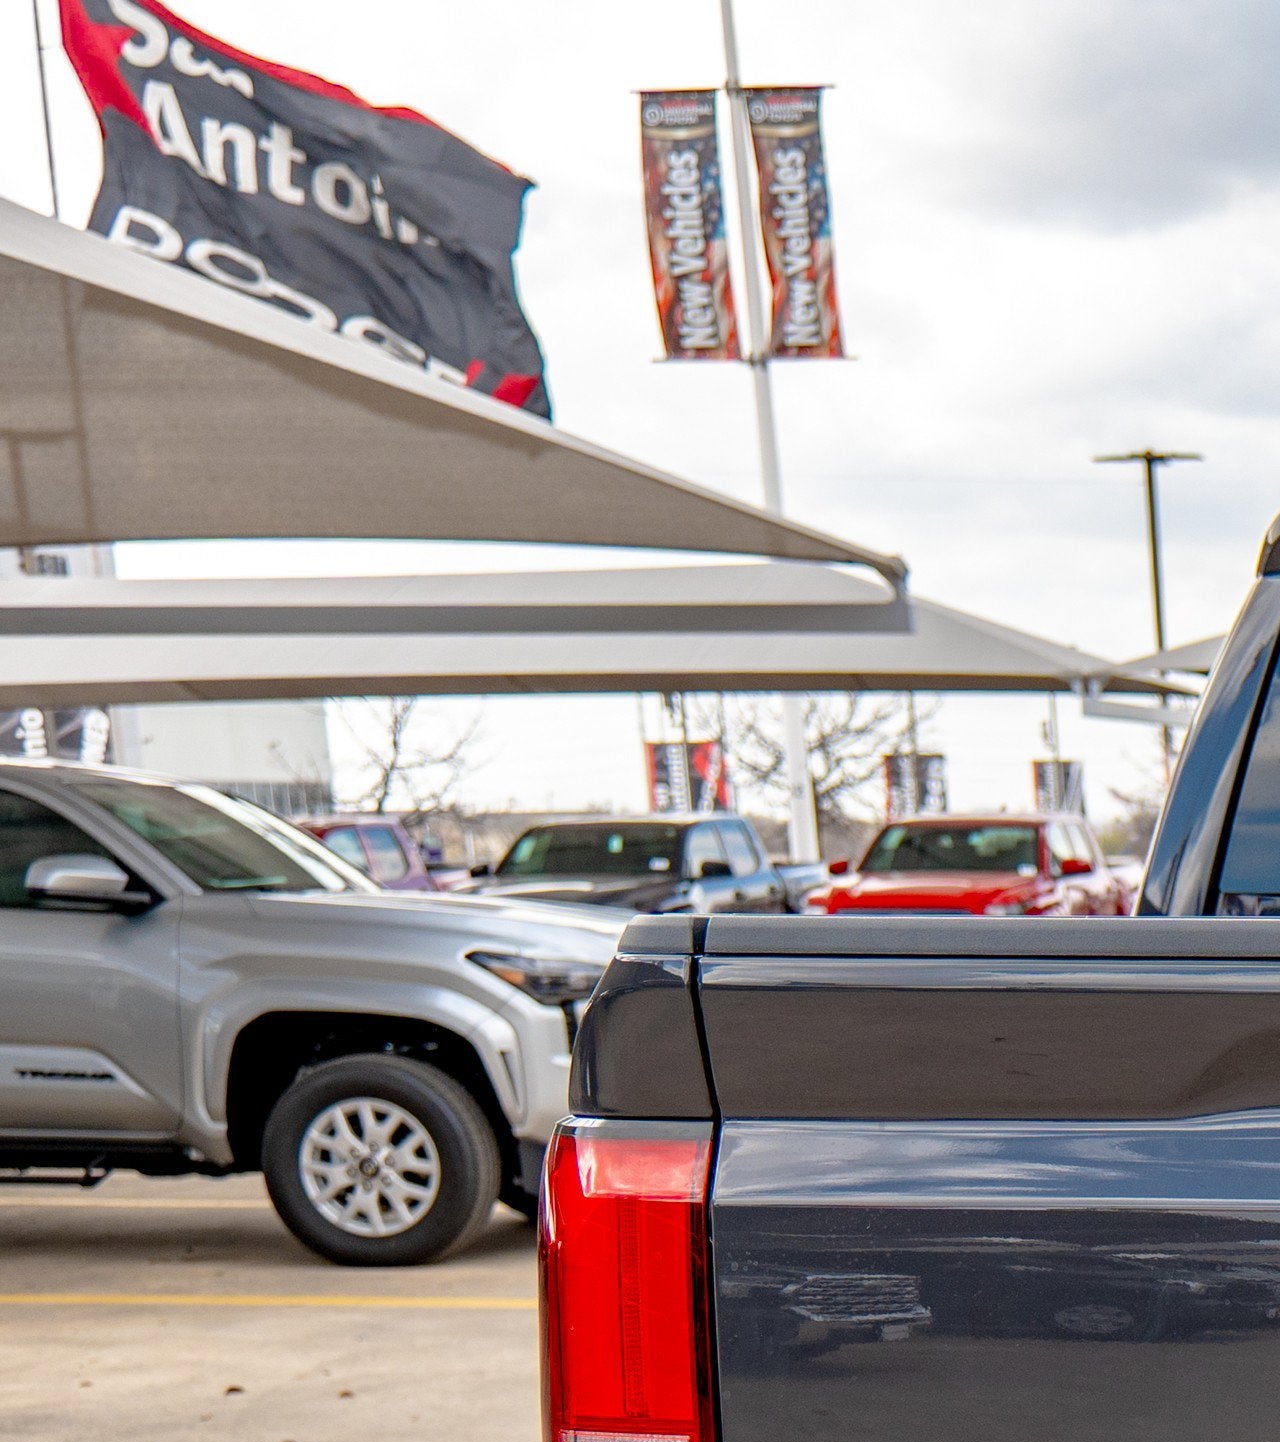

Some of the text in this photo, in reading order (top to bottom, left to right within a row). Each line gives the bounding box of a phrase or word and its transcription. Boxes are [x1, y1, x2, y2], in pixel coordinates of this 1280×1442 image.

[142, 80, 440, 247] Anto
[661, 150, 707, 277] Vehicles
[770, 148, 812, 277] Vehicles
[678, 279, 719, 348] New
[784, 280, 822, 347] New
